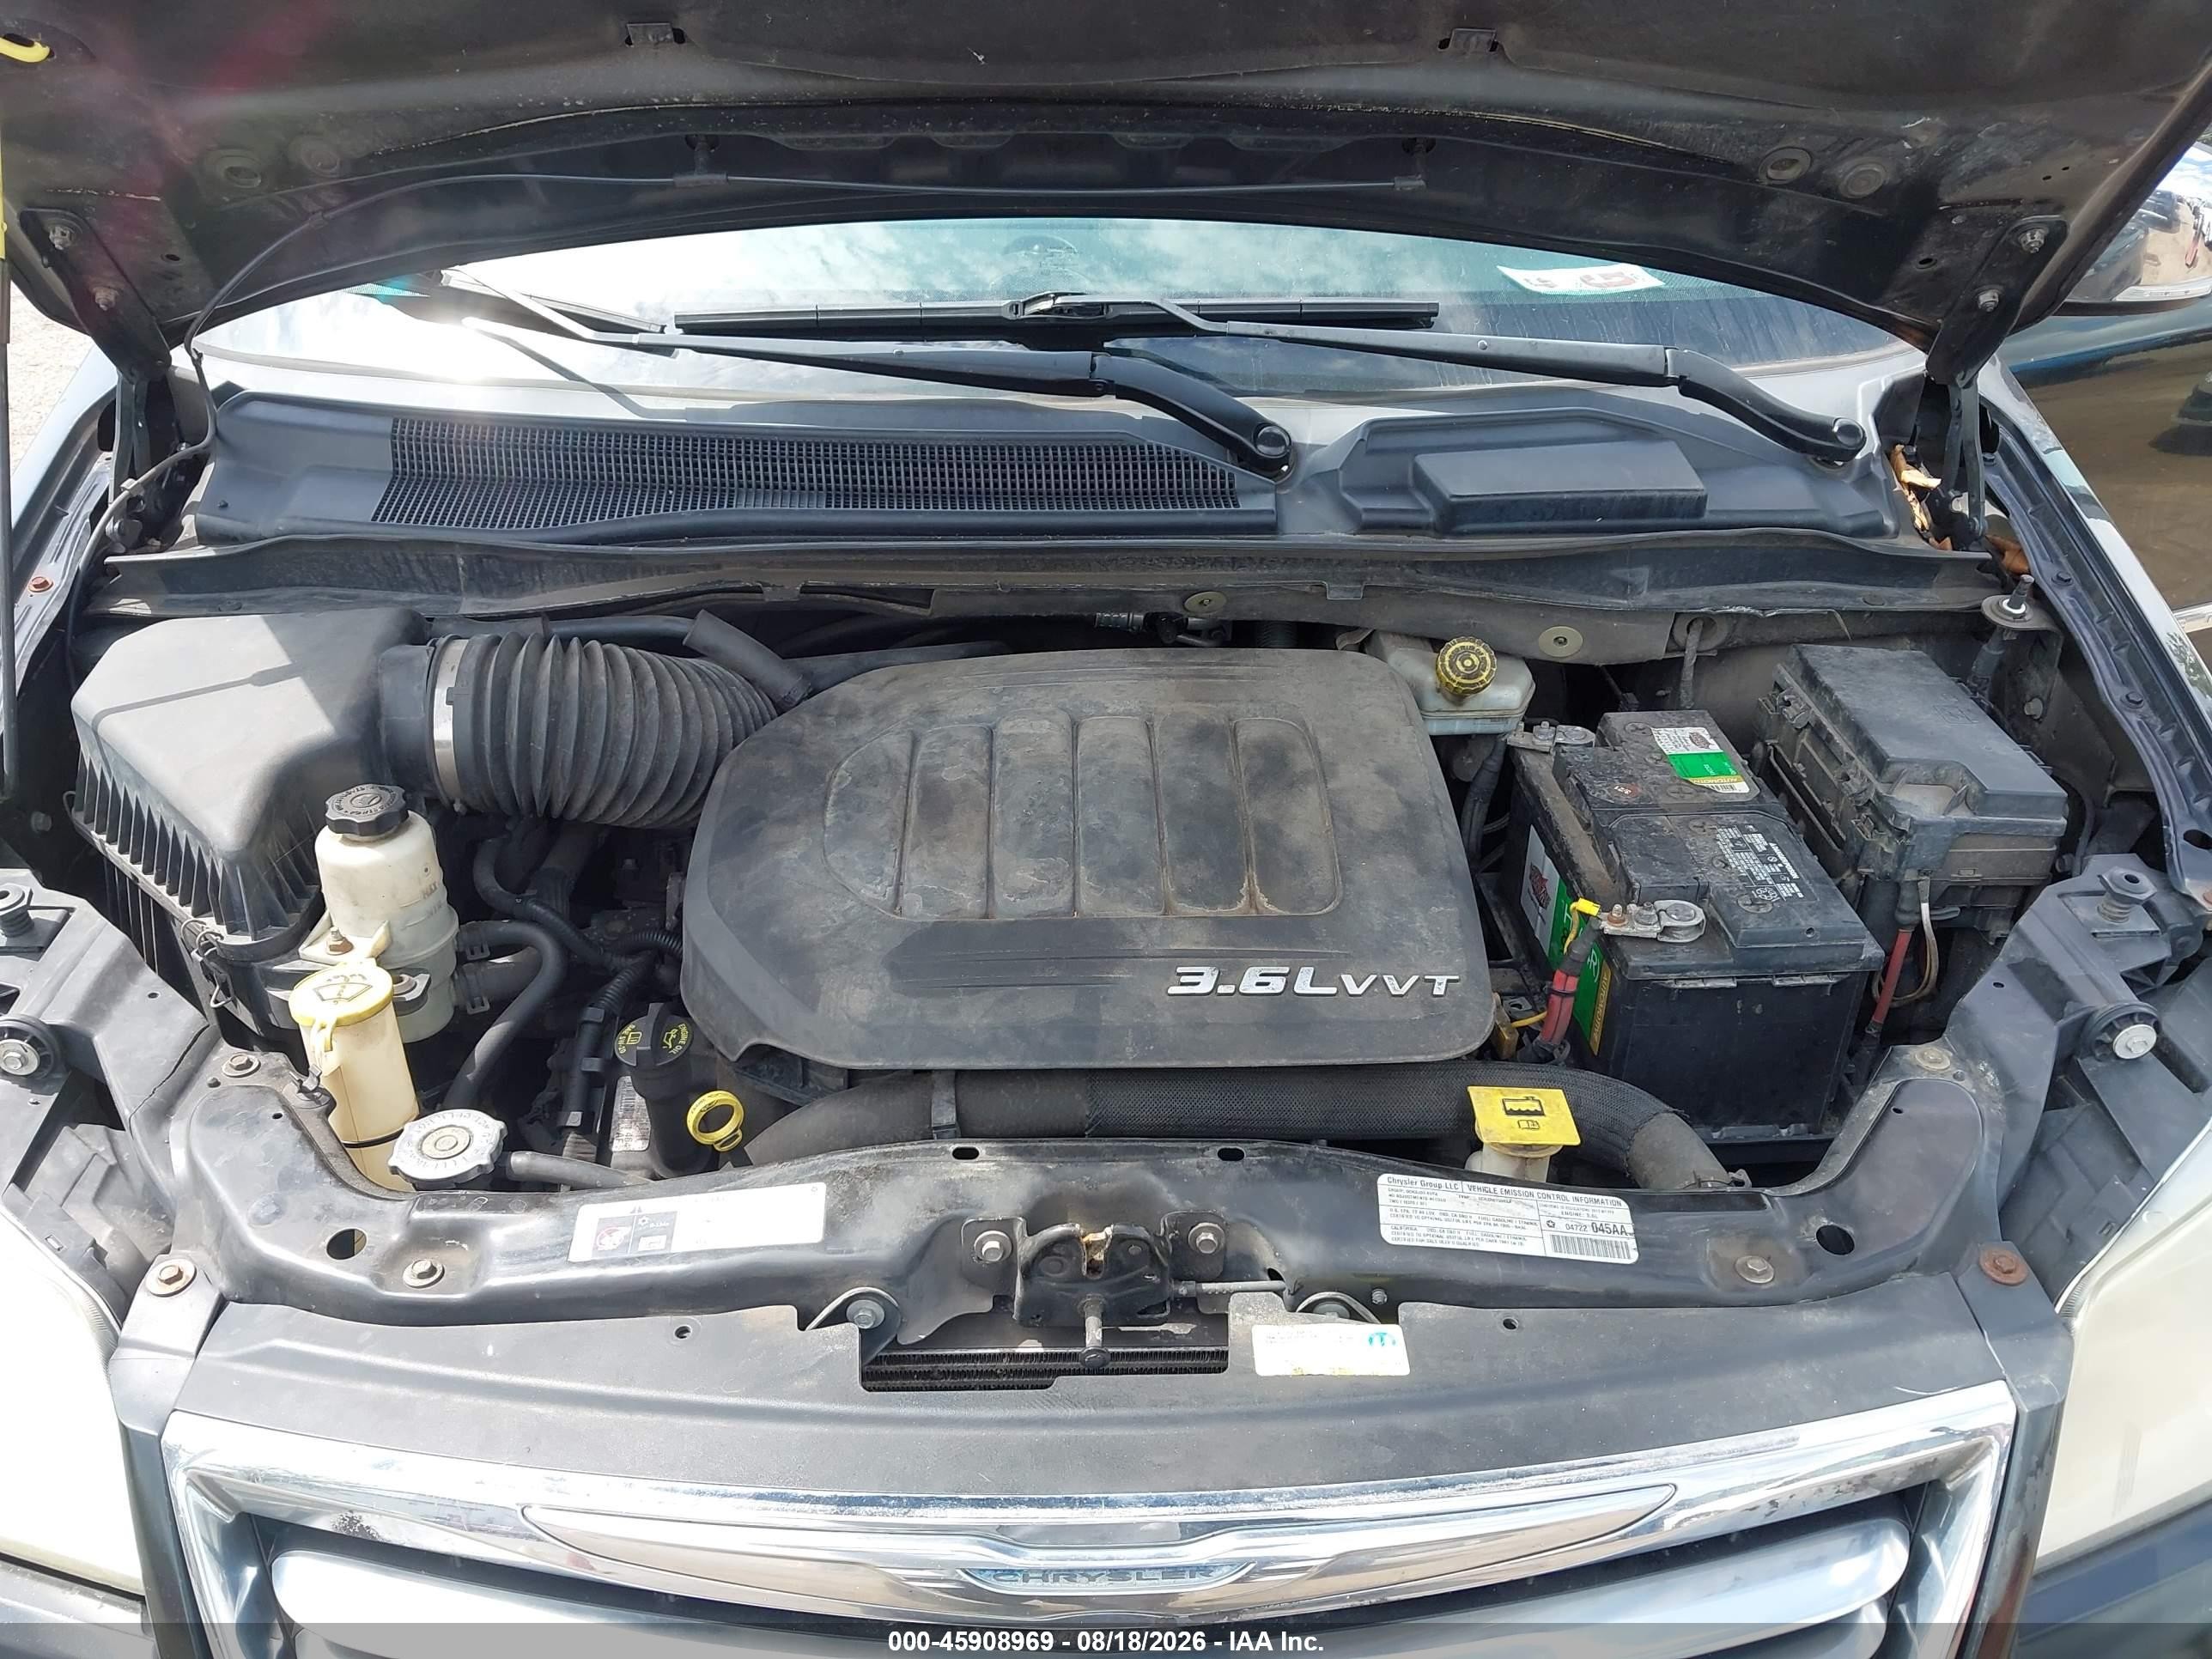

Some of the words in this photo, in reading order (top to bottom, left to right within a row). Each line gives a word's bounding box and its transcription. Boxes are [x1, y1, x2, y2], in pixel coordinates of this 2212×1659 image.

[1167, 966, 1338, 996] 3.6L
[1340, 974, 1461, 996] VVT
[678, 1023, 689, 1045] ENGINE
[668, 1045, 684, 1055] OIL
[1387, 1176, 1417, 1186] Chrysler
[1420, 1180, 1443, 1189] Group
[1468, 1184, 1498, 1195] VEHICLE
[1500, 1188, 1534, 1198] EMISSION
[1536, 1192, 1571, 1202] CONTROL
[1572, 1196, 1622, 1206] INFORMATION
[1565, 1223, 1588, 1232] 04722
[1591, 1222, 1629, 1237] 045AA
[992, 1569, 1213, 1583] CHRYSLER
